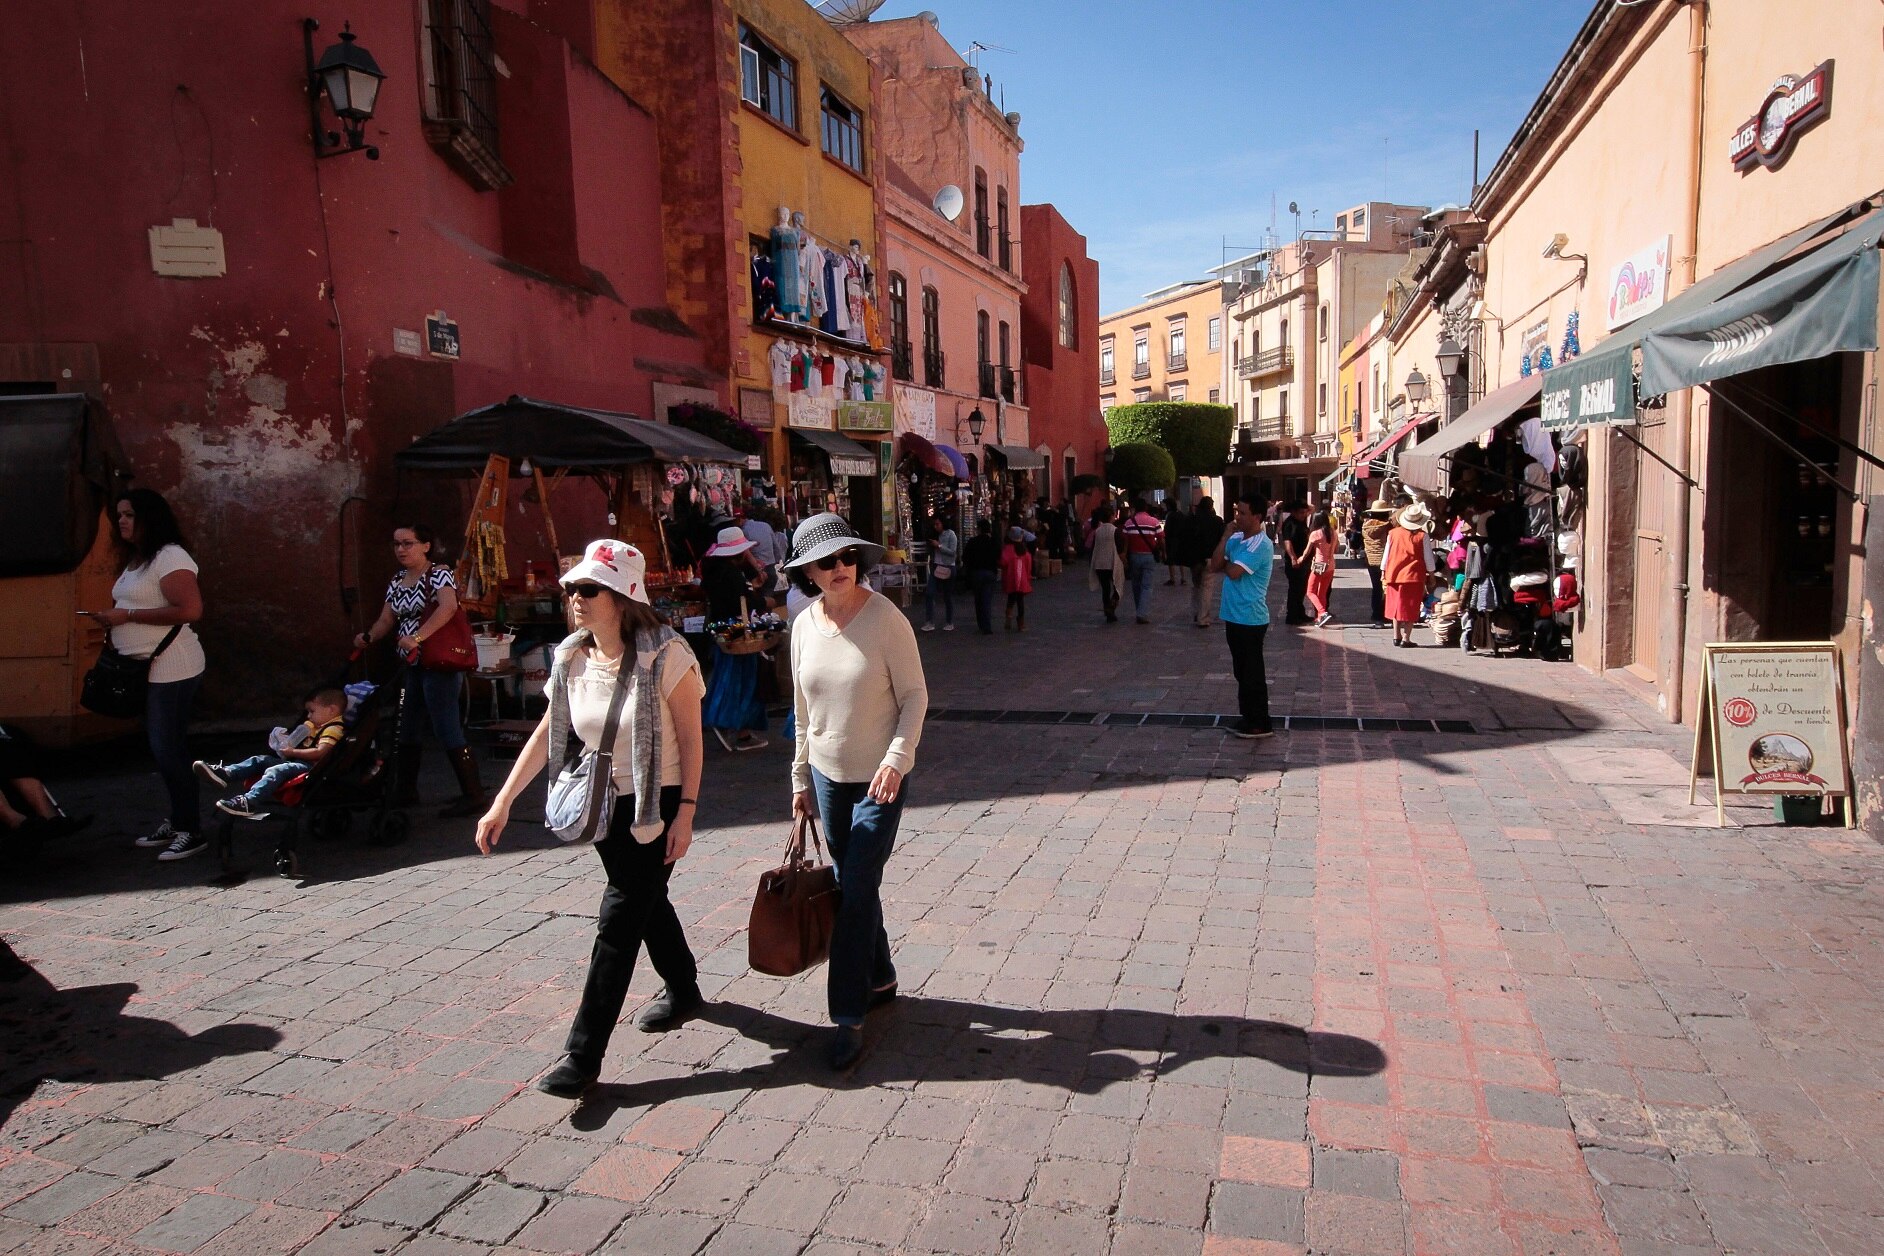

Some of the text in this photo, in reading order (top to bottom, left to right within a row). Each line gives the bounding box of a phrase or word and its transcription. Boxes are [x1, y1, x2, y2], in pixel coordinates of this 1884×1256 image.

[1717, 654, 1737, 664] Las
[1795, 654, 1829, 664] cuentan
[1747, 668, 1770, 679] boleto
[1773, 668, 1783, 678] de
[1727, 703, 1754, 718] 10%
[1762, 702, 1831, 715] de Descuento
